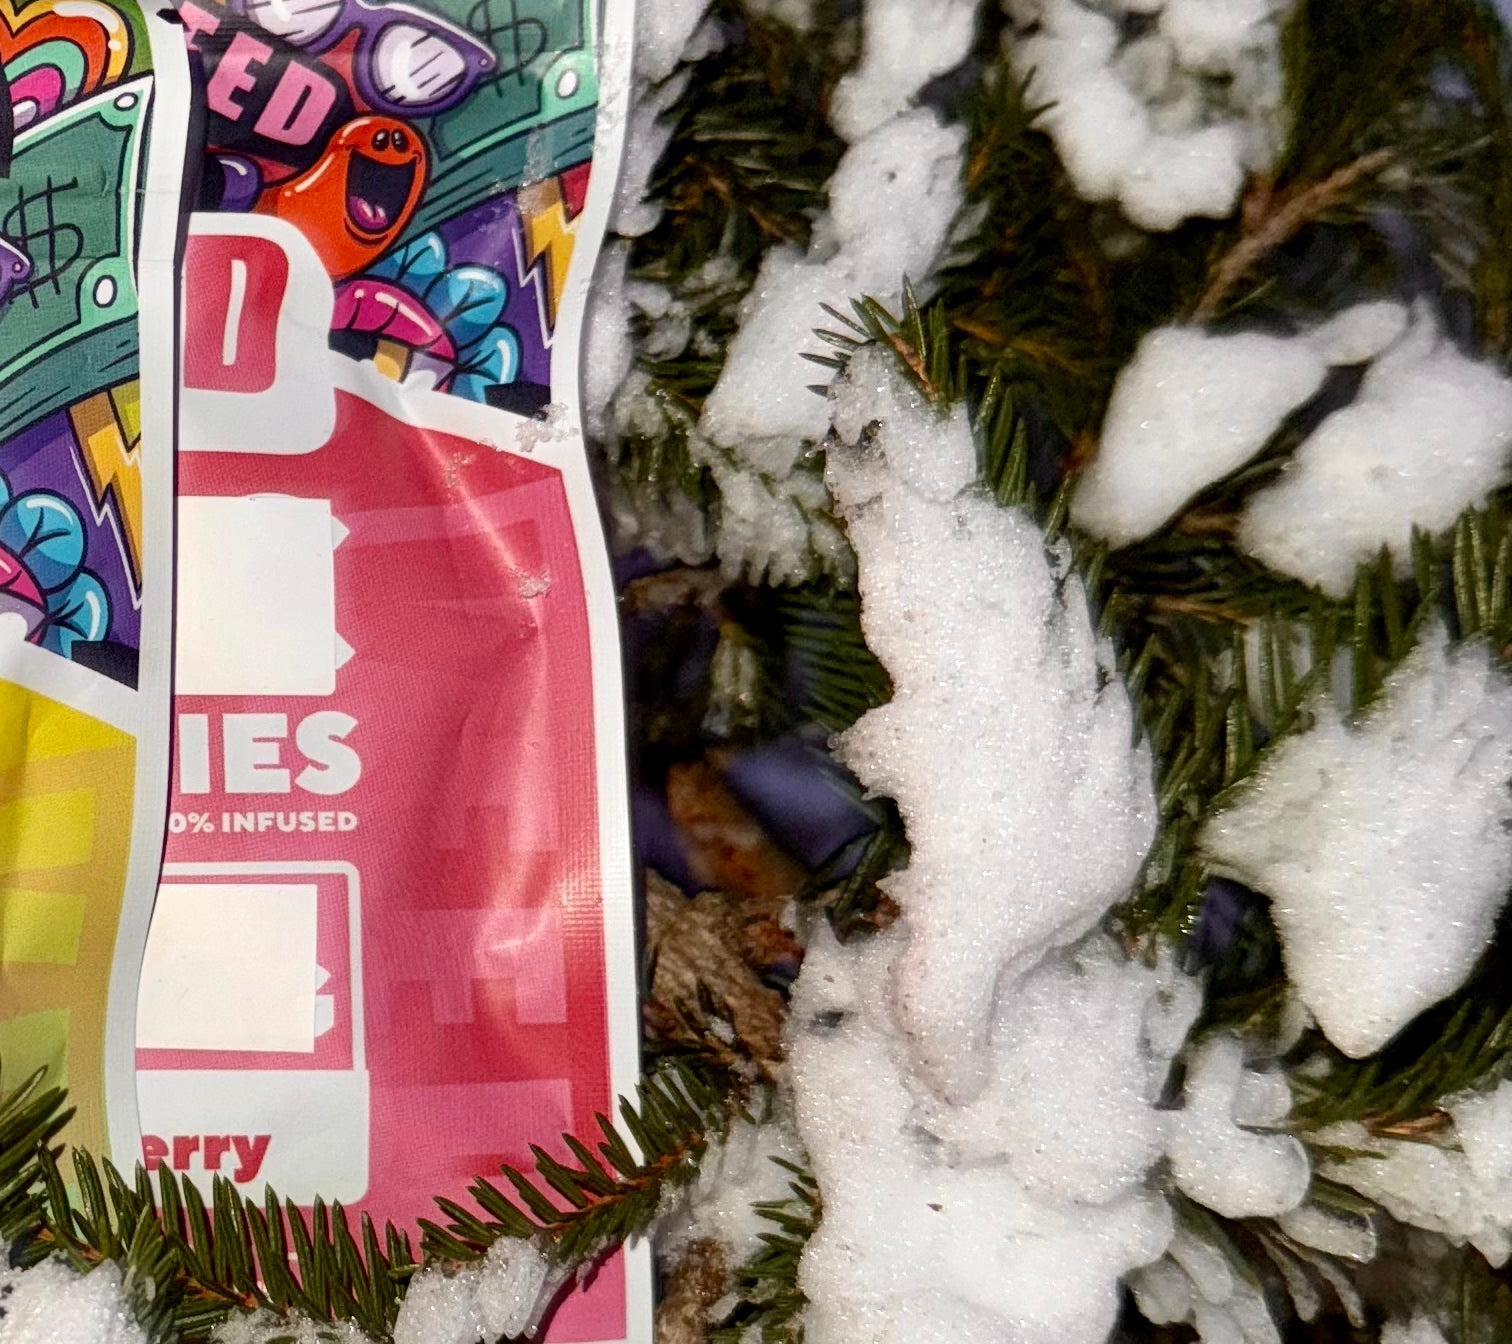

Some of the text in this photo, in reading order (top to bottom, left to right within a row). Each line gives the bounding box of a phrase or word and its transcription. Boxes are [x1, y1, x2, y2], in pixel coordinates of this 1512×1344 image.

[178, 710, 363, 796] IES
[221, 811, 358, 833] INFUSED
[140, 1133, 272, 1184] erry
